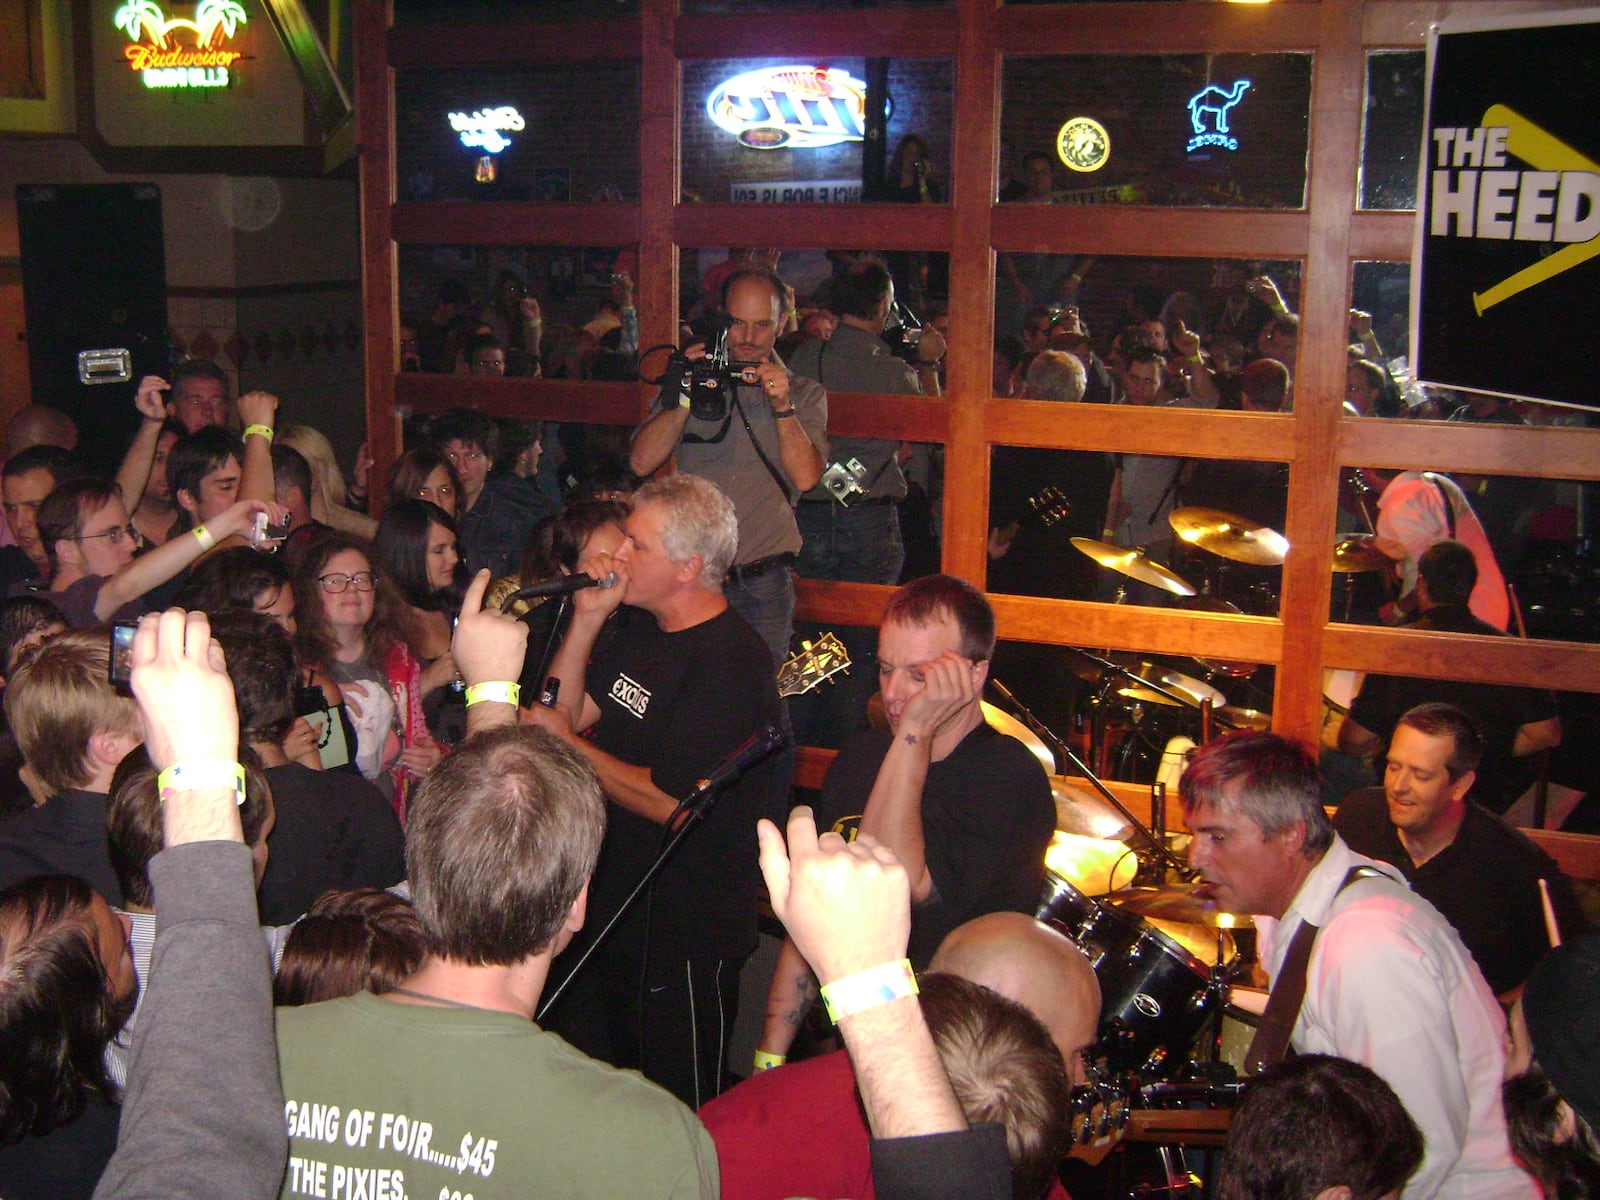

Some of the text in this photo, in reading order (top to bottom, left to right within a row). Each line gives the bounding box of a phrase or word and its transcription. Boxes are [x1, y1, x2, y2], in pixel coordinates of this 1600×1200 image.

[1433, 127, 1510, 168] THE
[1430, 170, 1600, 244] HEED
[284, 1100, 341, 1143] GANG
[344, 1108, 375, 1148] OF
[289, 1156, 328, 1199] THE
